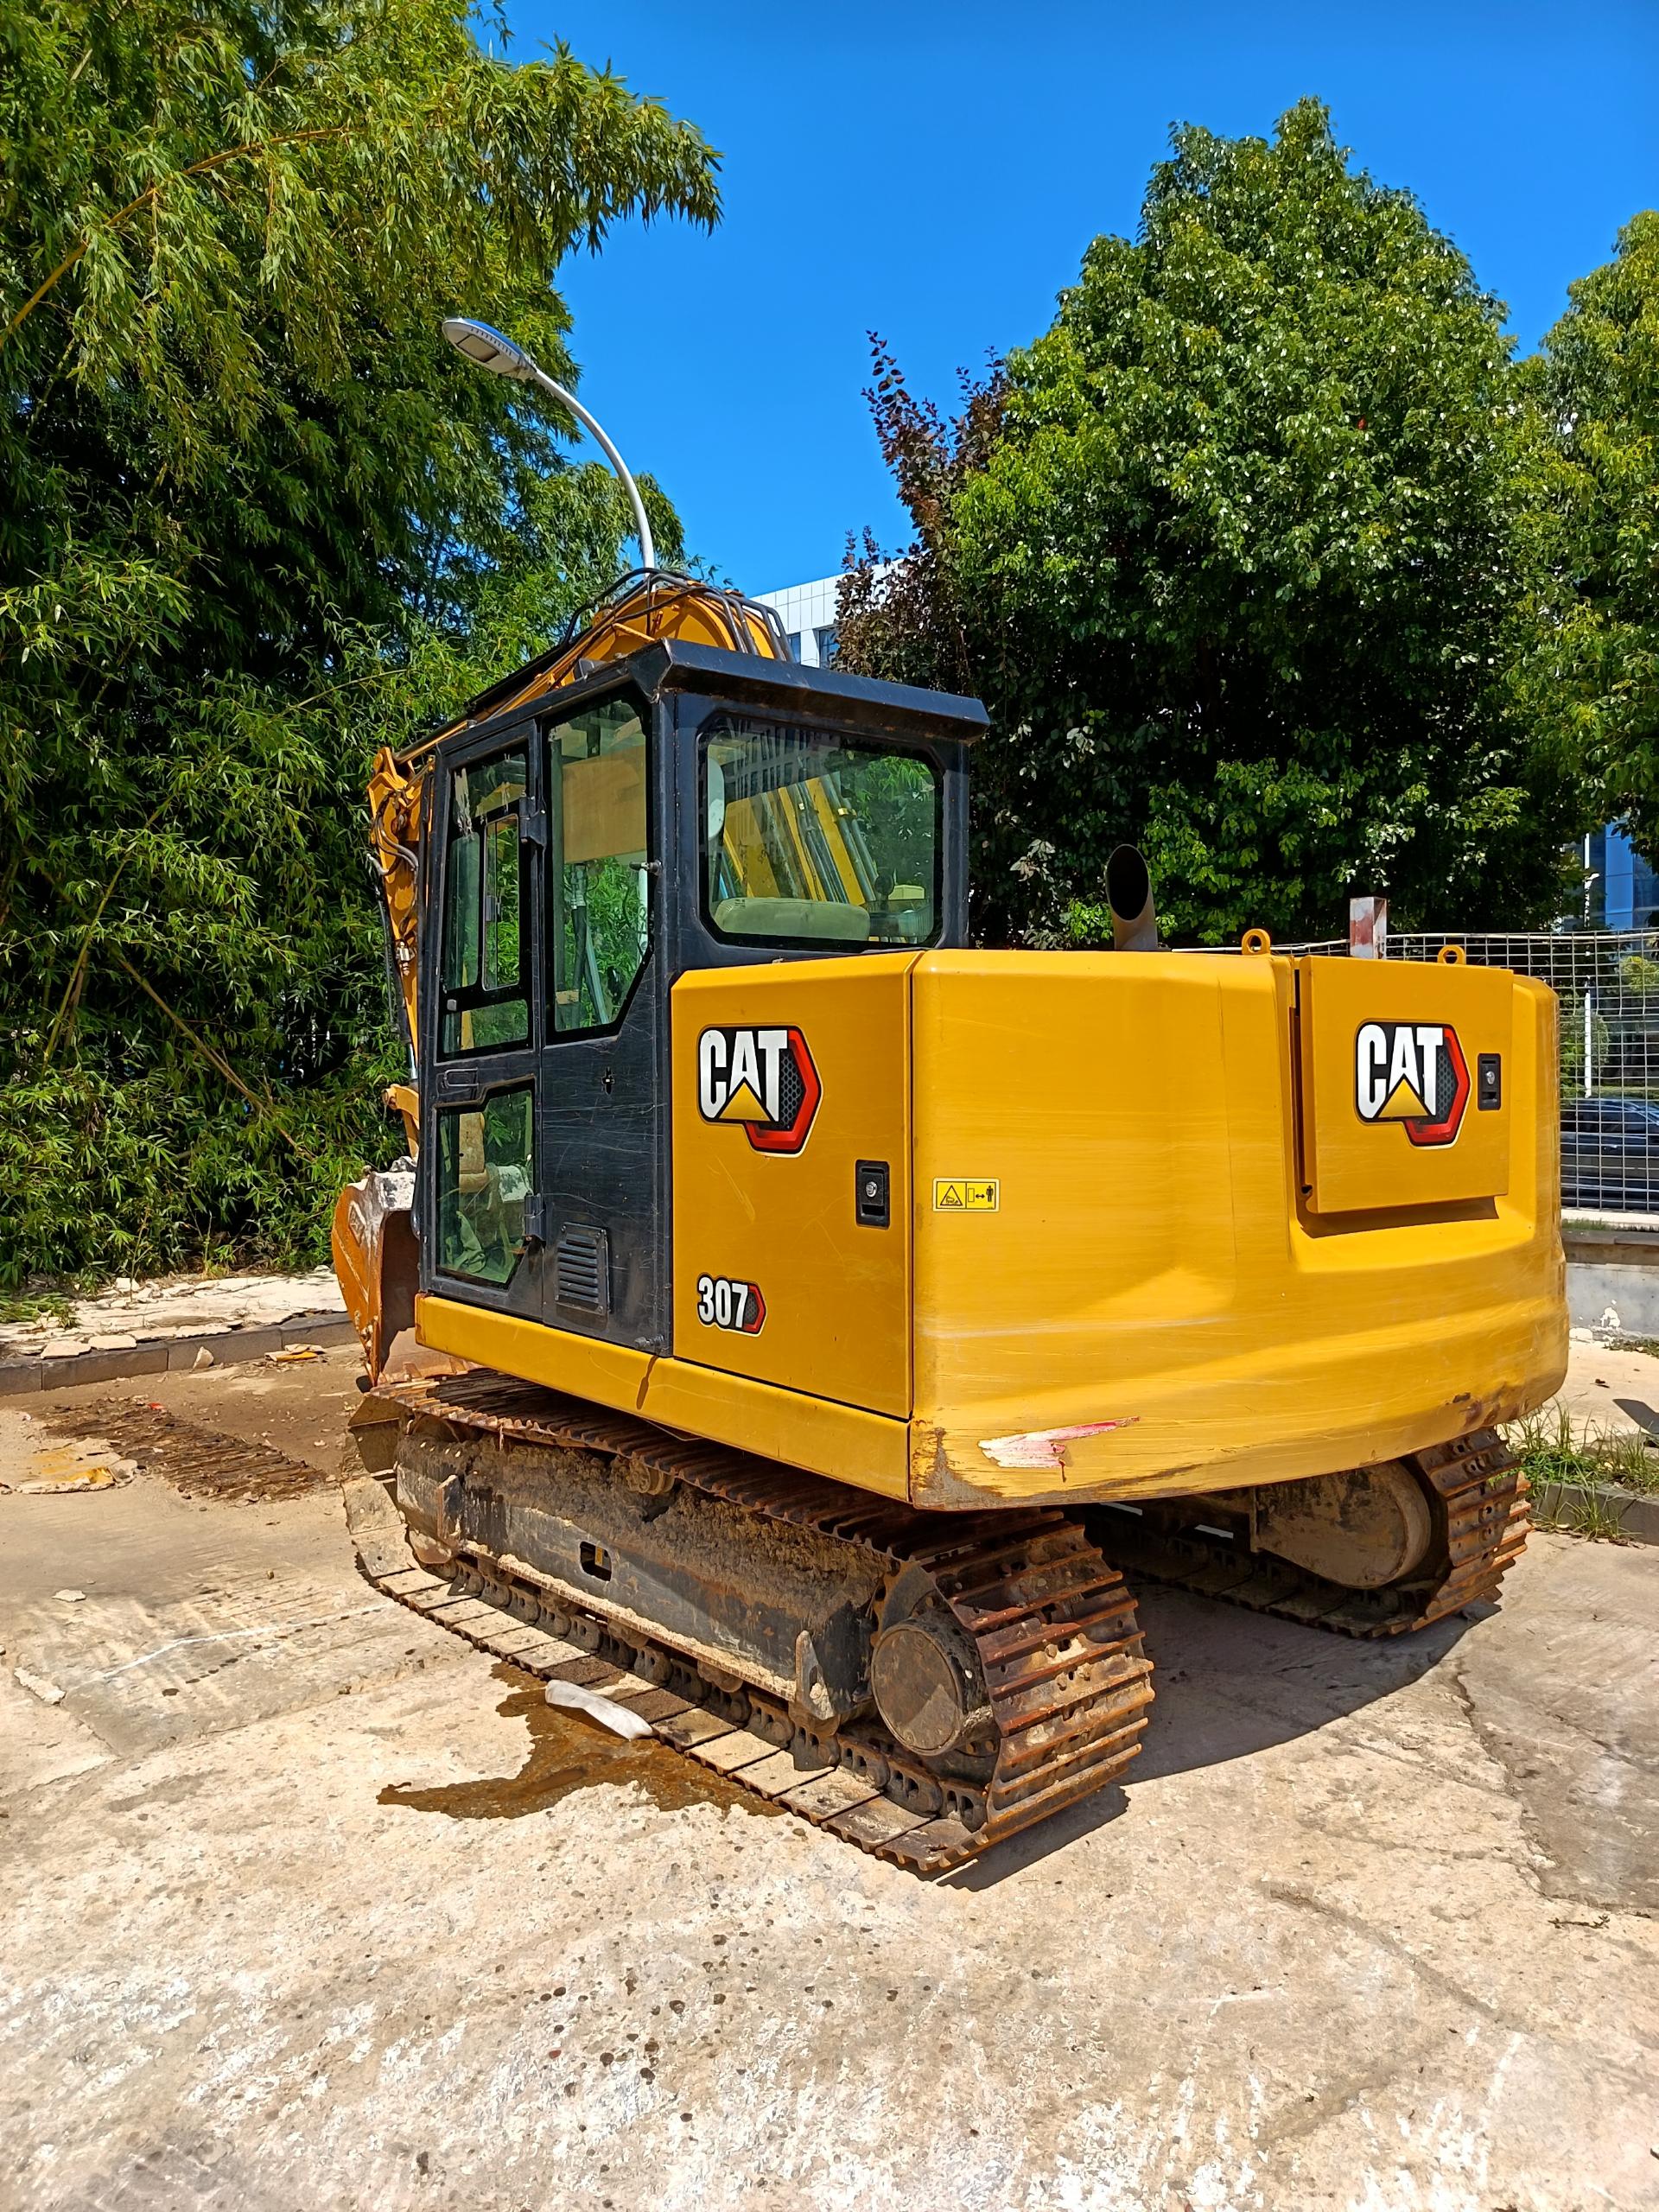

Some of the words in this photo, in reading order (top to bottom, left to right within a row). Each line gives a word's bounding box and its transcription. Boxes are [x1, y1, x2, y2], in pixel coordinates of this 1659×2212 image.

[699, 1029, 787, 1122] CAT
[1357, 1023, 1444, 1119] CAT
[698, 1276, 748, 1328] 307
